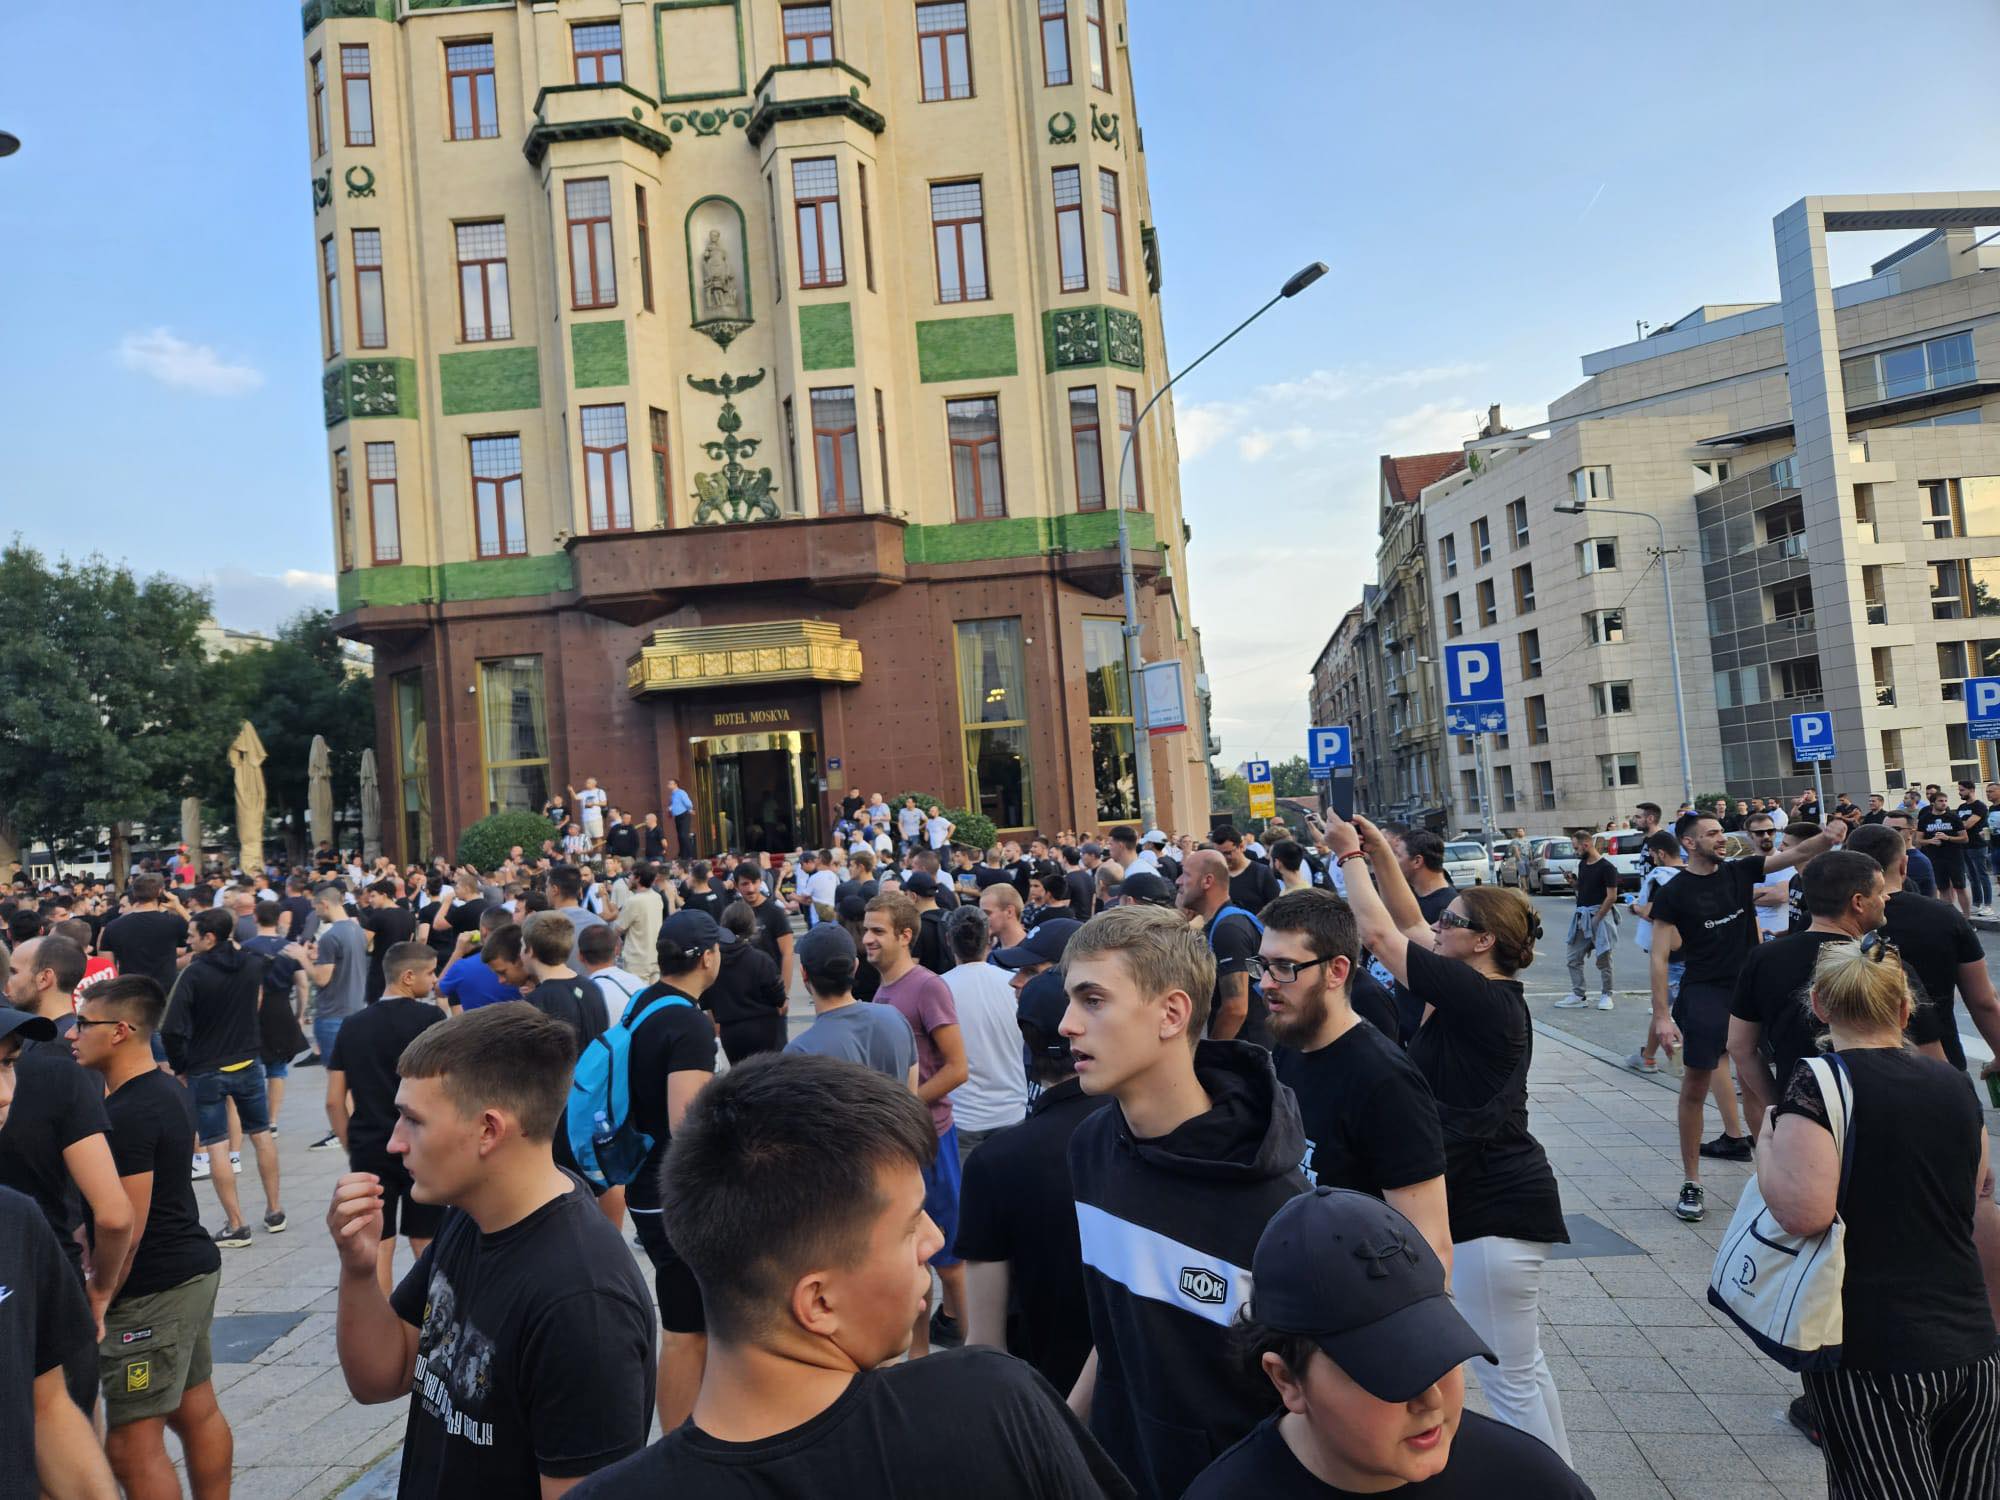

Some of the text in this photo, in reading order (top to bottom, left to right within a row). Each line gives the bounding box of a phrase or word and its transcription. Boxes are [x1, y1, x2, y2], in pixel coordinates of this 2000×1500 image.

[1457, 650, 1489, 697] P
[1976, 682, 2000, 716] P
[714, 709, 790, 726] HOTEL MOSKVA
[1800, 717, 1823, 744] P
[1316, 732, 1341, 764] P
[1252, 763, 1266, 781] P
[1183, 1273, 1223, 1298] ПФК
